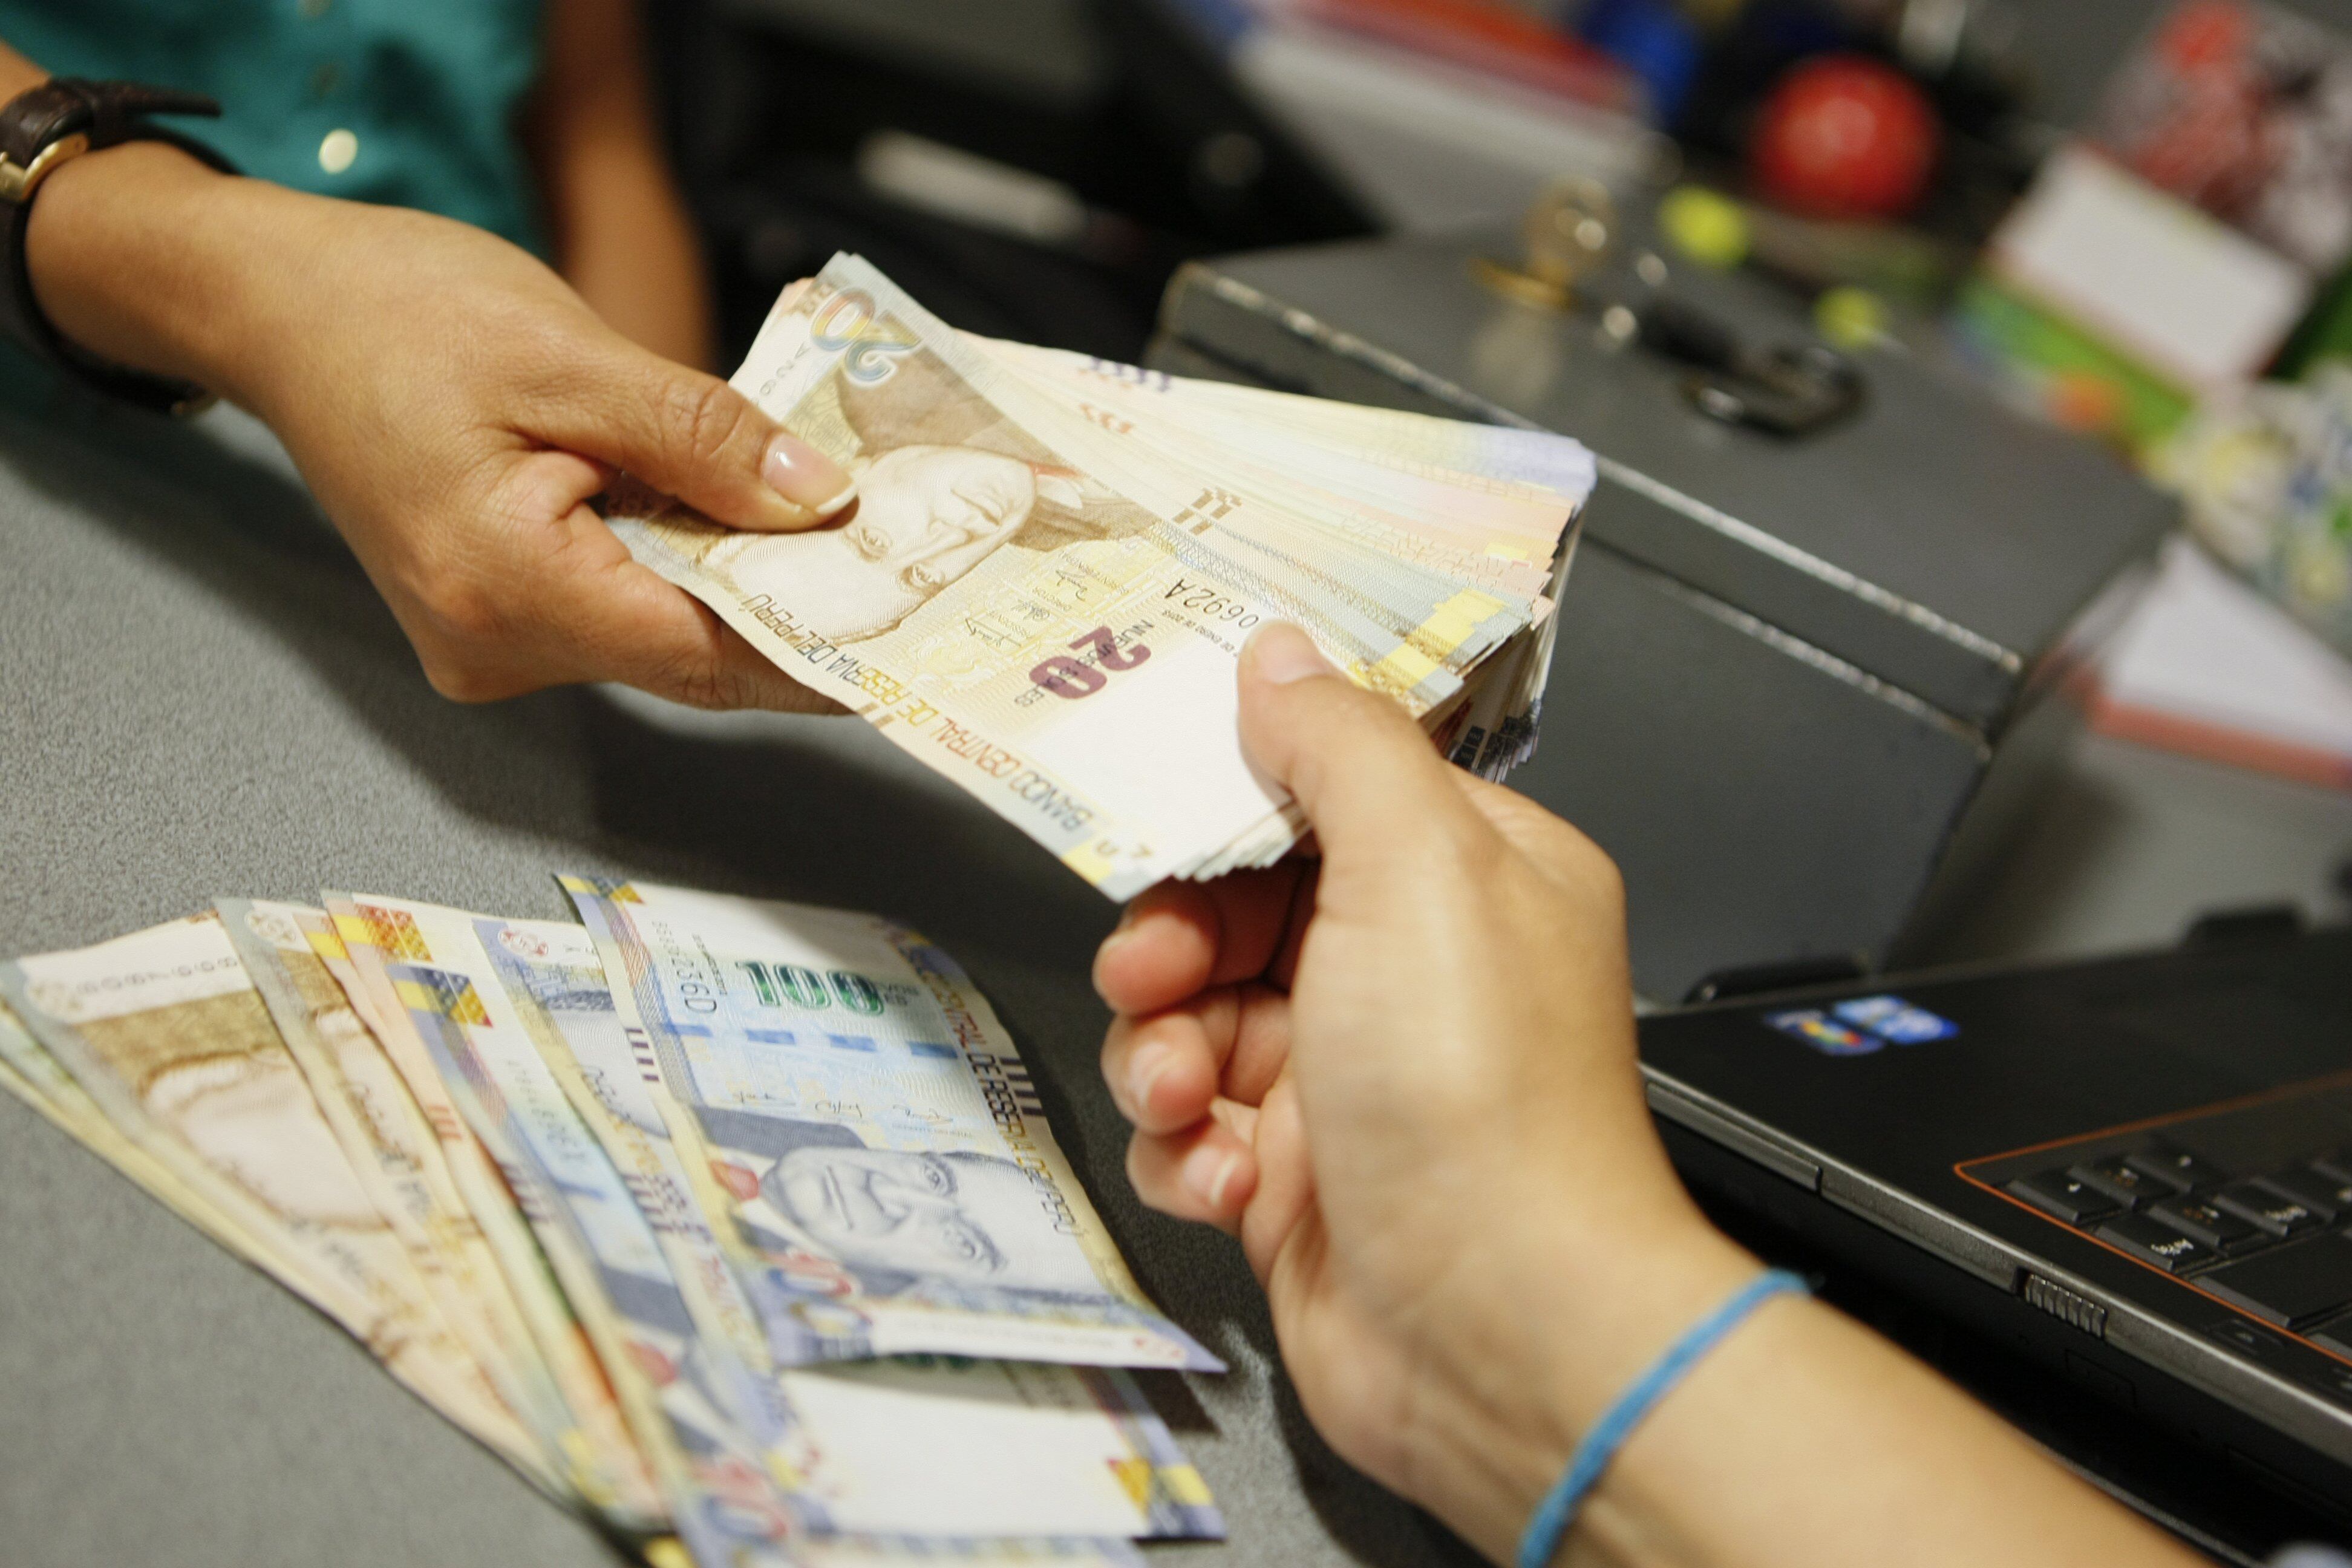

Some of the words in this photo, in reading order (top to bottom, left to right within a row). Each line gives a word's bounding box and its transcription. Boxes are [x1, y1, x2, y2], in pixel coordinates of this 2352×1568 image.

[811, 287, 921, 382] 20
[792, 630, 838, 664] DEL
[1029, 626, 1151, 699] 20
[825, 652, 913, 705] RESERVA
[897, 697, 939, 727] DE
[930, 716, 1022, 779] CENTRAL
[1008, 769, 1094, 831] BANCO
[734, 959, 884, 1016] 100
